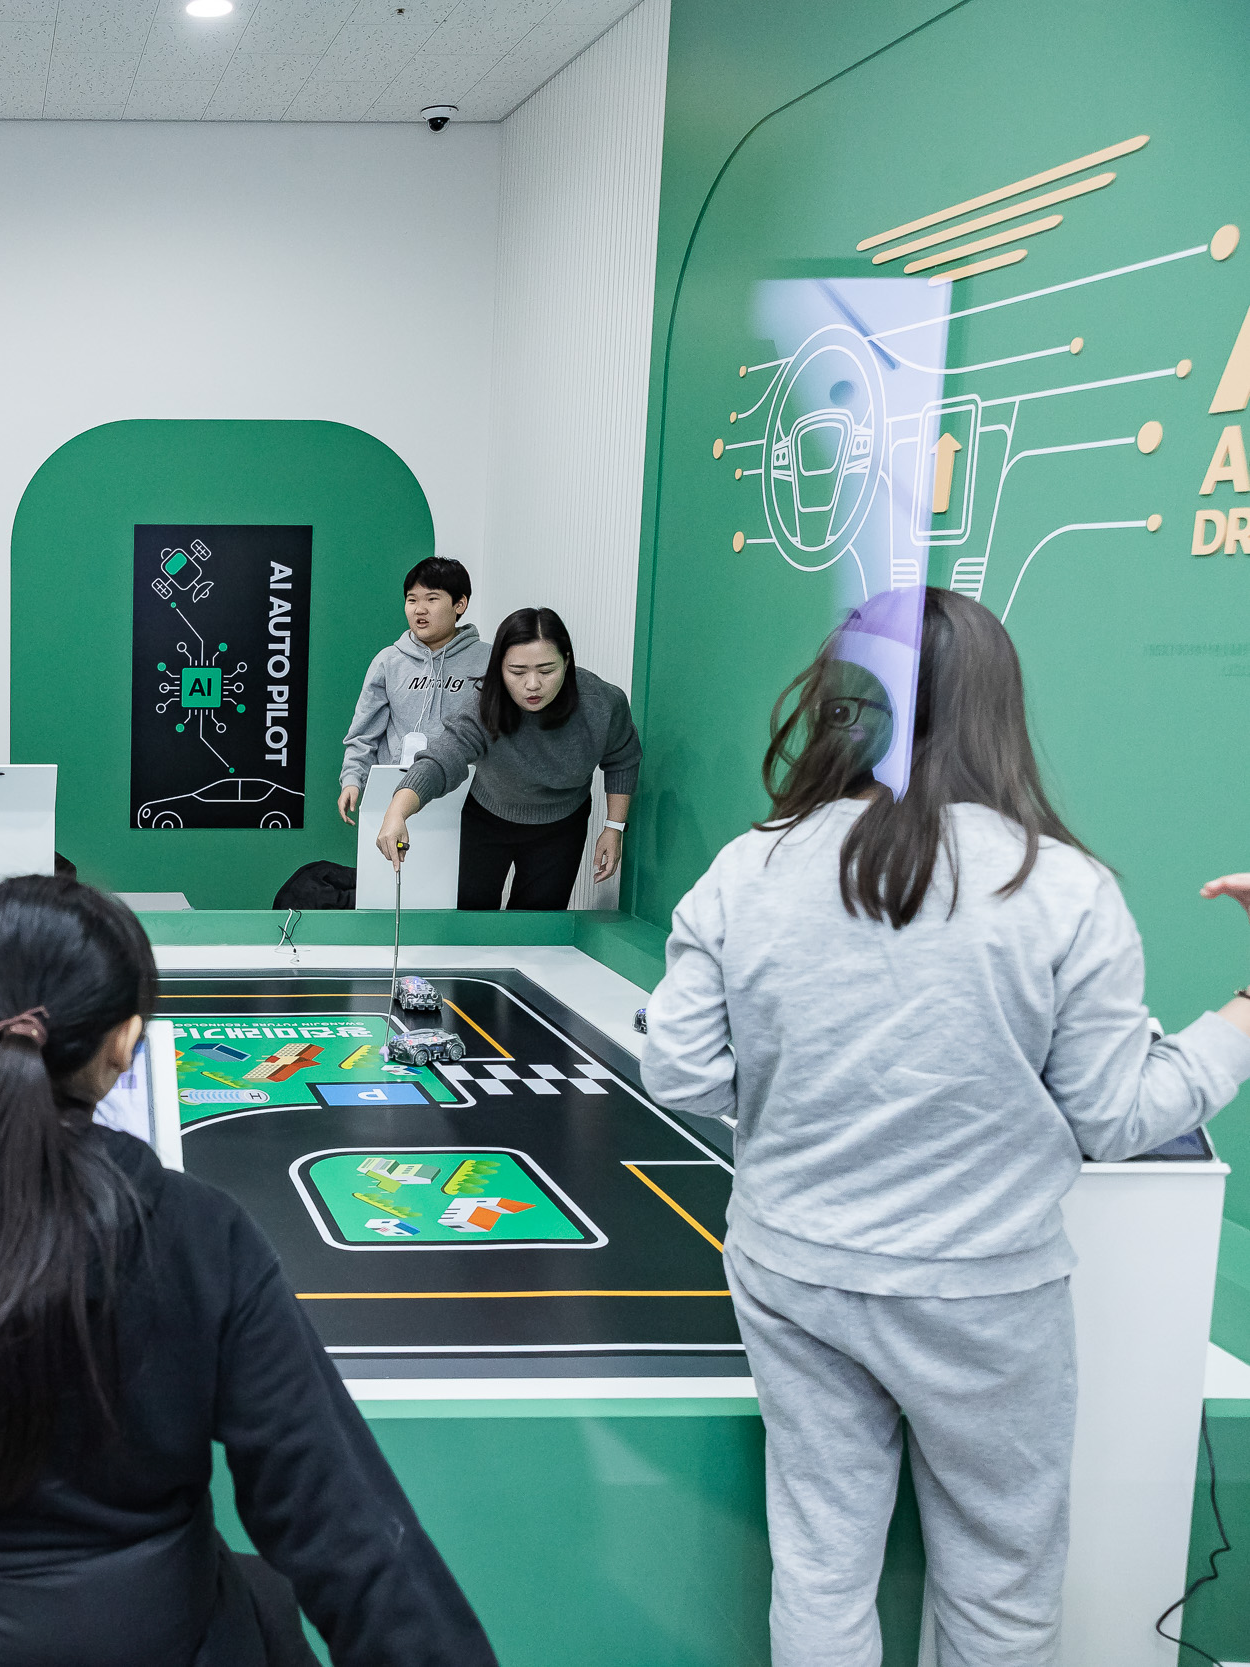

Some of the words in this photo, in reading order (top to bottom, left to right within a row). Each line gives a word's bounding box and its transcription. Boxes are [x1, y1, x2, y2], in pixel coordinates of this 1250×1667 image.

[269, 561, 292, 589] AI
[267, 596, 291, 678] AUTO
[188, 677, 212, 697] AI
[265, 685, 289, 767] PILOT
[357, 1088, 388, 1101] P
